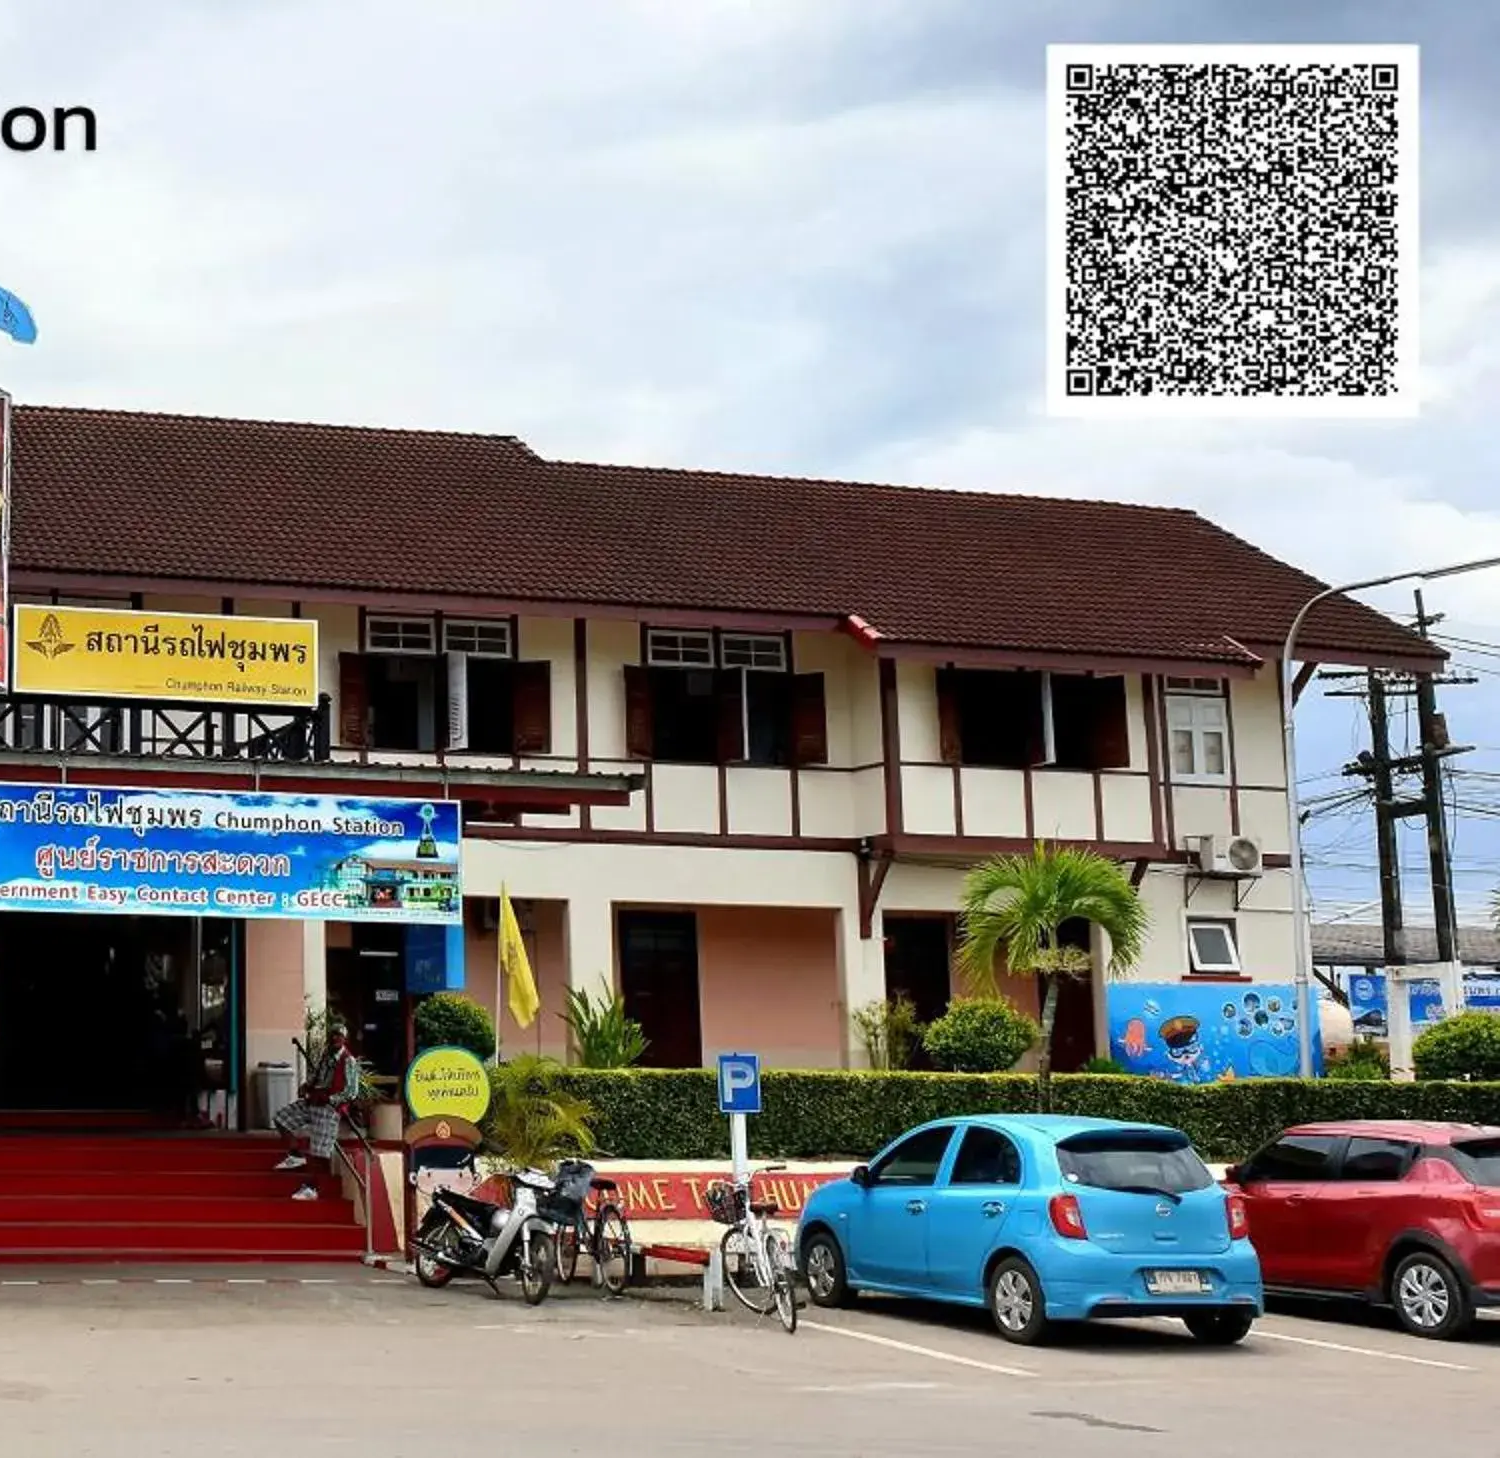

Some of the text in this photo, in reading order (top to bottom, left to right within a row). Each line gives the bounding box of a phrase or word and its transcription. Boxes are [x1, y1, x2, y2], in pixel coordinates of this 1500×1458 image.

[86, 624, 307, 673] สถานีรถไฟชุมพร
[227, 681, 267, 697] Railway
[271, 684, 307, 697] Station
[214, 810, 323, 836] Chumphon
[332, 818, 405, 837] Station
[36, 836, 290, 877] ศูนย์ราชการสะดวก
[87, 885, 128, 905] Easy
[137, 885, 207, 904] Contact
[215, 888, 274, 906] Center
[723, 1061, 755, 1103] P
